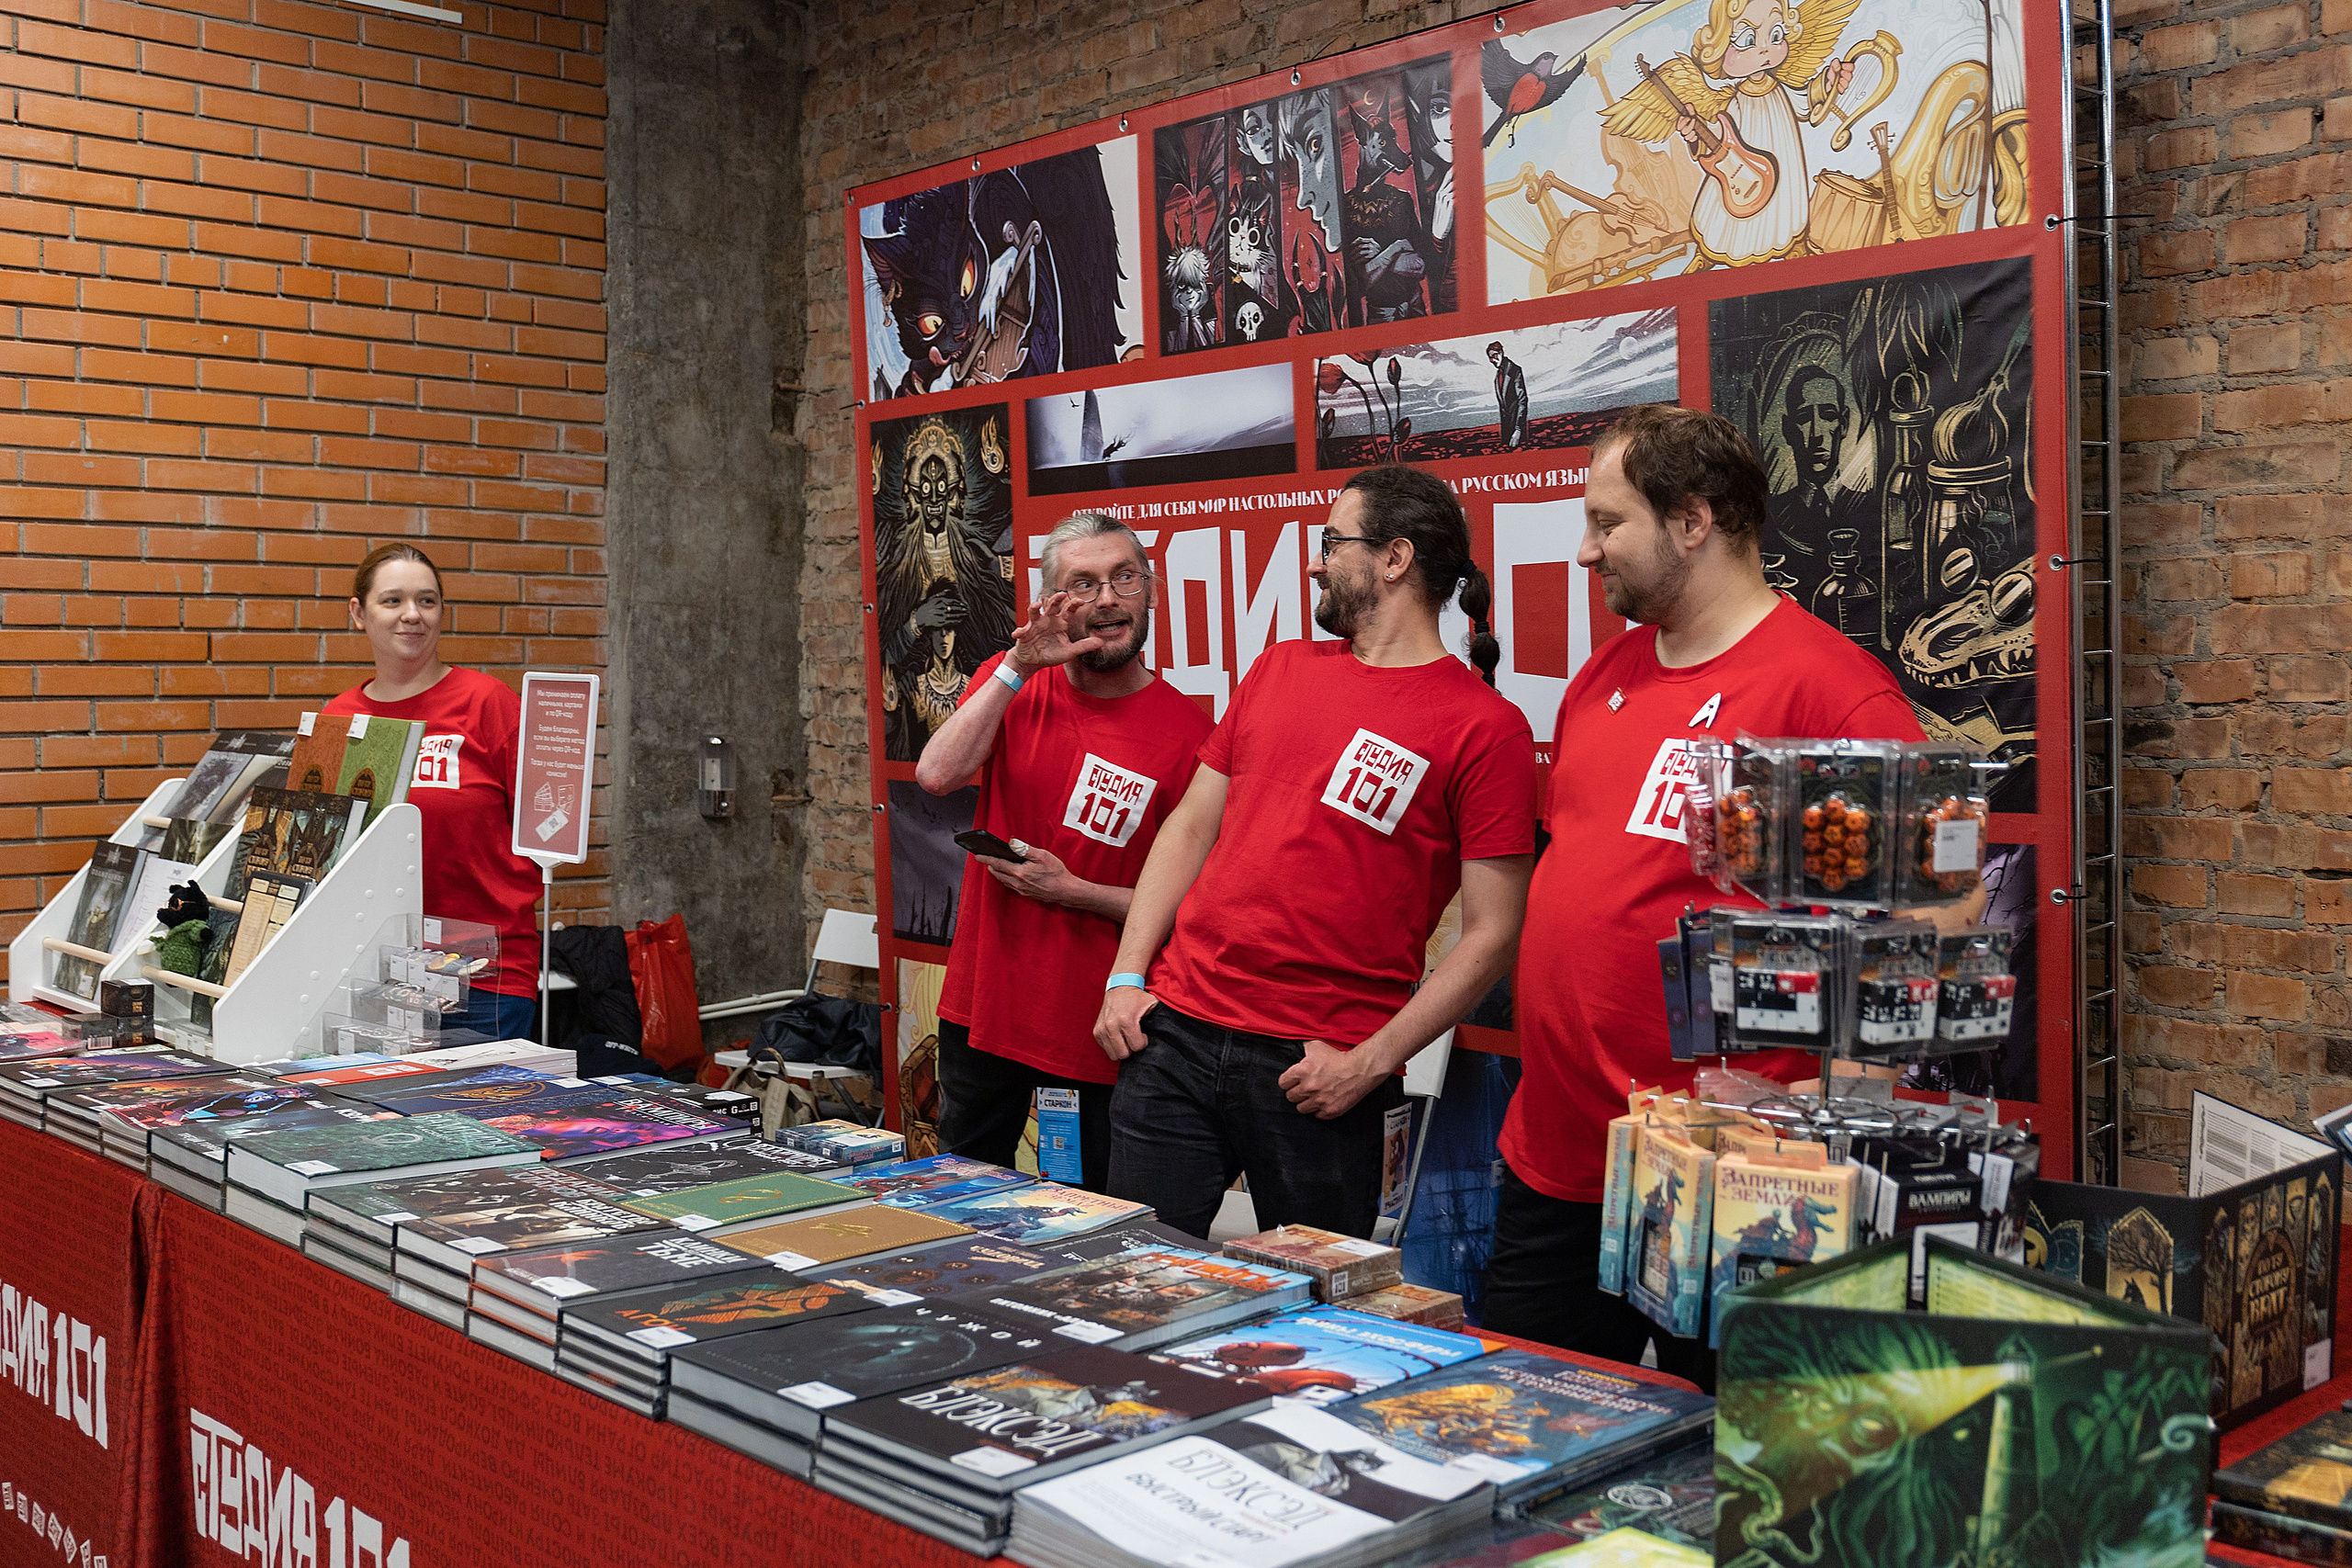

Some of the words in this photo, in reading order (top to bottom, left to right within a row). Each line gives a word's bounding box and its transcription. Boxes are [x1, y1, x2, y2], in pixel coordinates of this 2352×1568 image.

[1136, 502, 1162, 521] ДЛЯ
[1164, 501, 1196, 518] СЕБЯ
[1198, 498, 1227, 514] МИР
[1228, 490, 1325, 513] НАСТОЛЬНЫХ
[1462, 472, 1542, 494] РУССКОМ
[1545, 468, 1590, 488] ЯЗЫ
[418, 755, 448, 782] 01
[1337, 766, 1398, 822] 101
[1643, 781, 1686, 830] 10
[1077, 792, 1131, 839] 101
[408, 1112, 517, 1149] ВАМПИРЫ
[622, 1098, 720, 1131] ВАМПИРЫ
[523, 1166, 627, 1198] ПРЕДАНИЯ
[1042, 1186, 1129, 1211] ЗАПРЕТНЫЕ
[1722, 1167, 1839, 1198] ЗАПРЕТНЫЕ
[1731, 1188, 1795, 1206] ЗЕМЛИ
[1907, 1190, 1972, 1210] ВАМПИРЫ
[636, 1242, 714, 1269] ТЬМЕ
[668, 1236, 749, 1263] КЛИНКИ
[914, 1306, 1043, 1349] ЧУЖОЙ
[0, 1282, 50, 1405] ДИЯ
[53, 1312, 108, 1450] 101
[898, 1382, 1106, 1459] БЛЭКСЭД
[1167, 1448, 1334, 1531] БЛЭКСЭД
